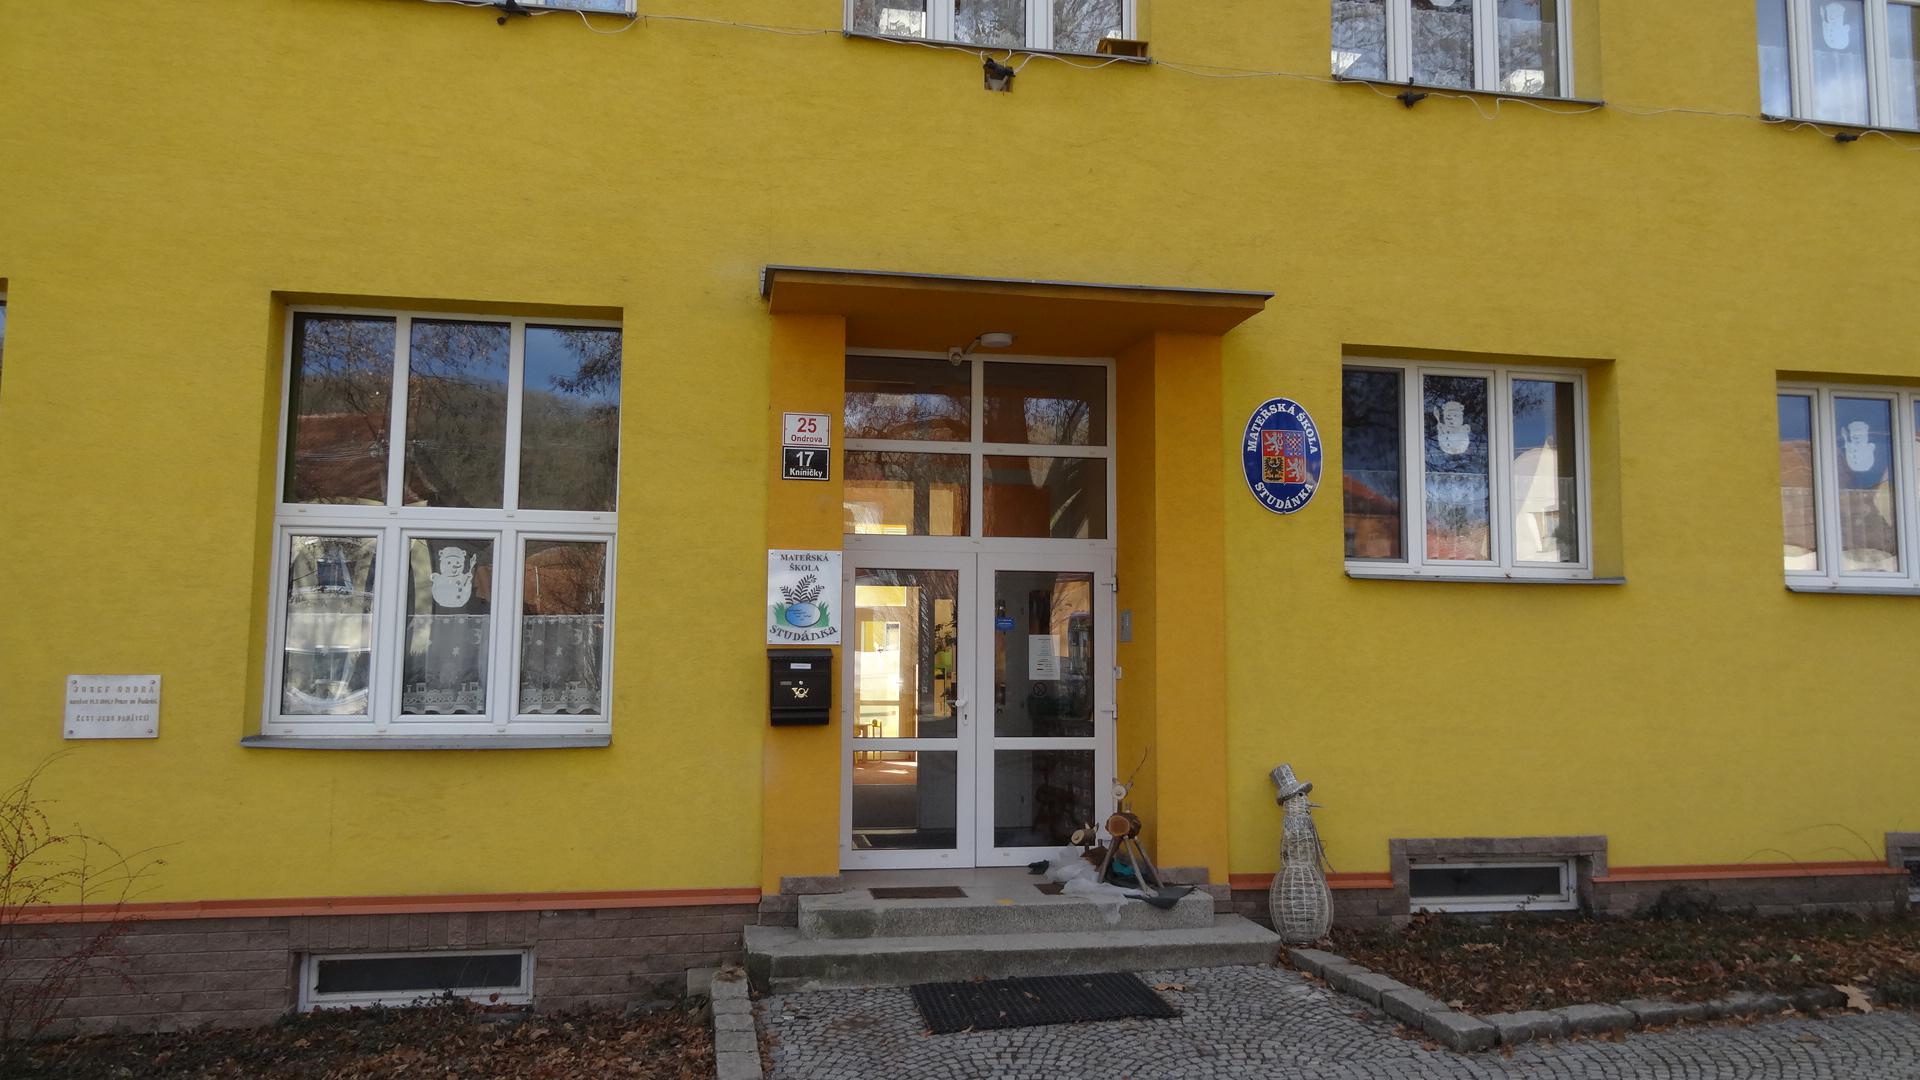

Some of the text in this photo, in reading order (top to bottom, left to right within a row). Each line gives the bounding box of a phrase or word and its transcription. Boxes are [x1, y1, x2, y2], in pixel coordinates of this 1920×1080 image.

[797, 417, 817, 433] 25
[1247, 403, 1318, 454] MATEŘSKÁ ŠKOLA
[791, 434, 823, 443] Ondrova
[796, 451, 814, 467] 17
[1254, 481, 1314, 509] STUDÁNKA
[780, 553, 829, 562] MATEŘSKÁ
[789, 562, 820, 572] ŠKOLA
